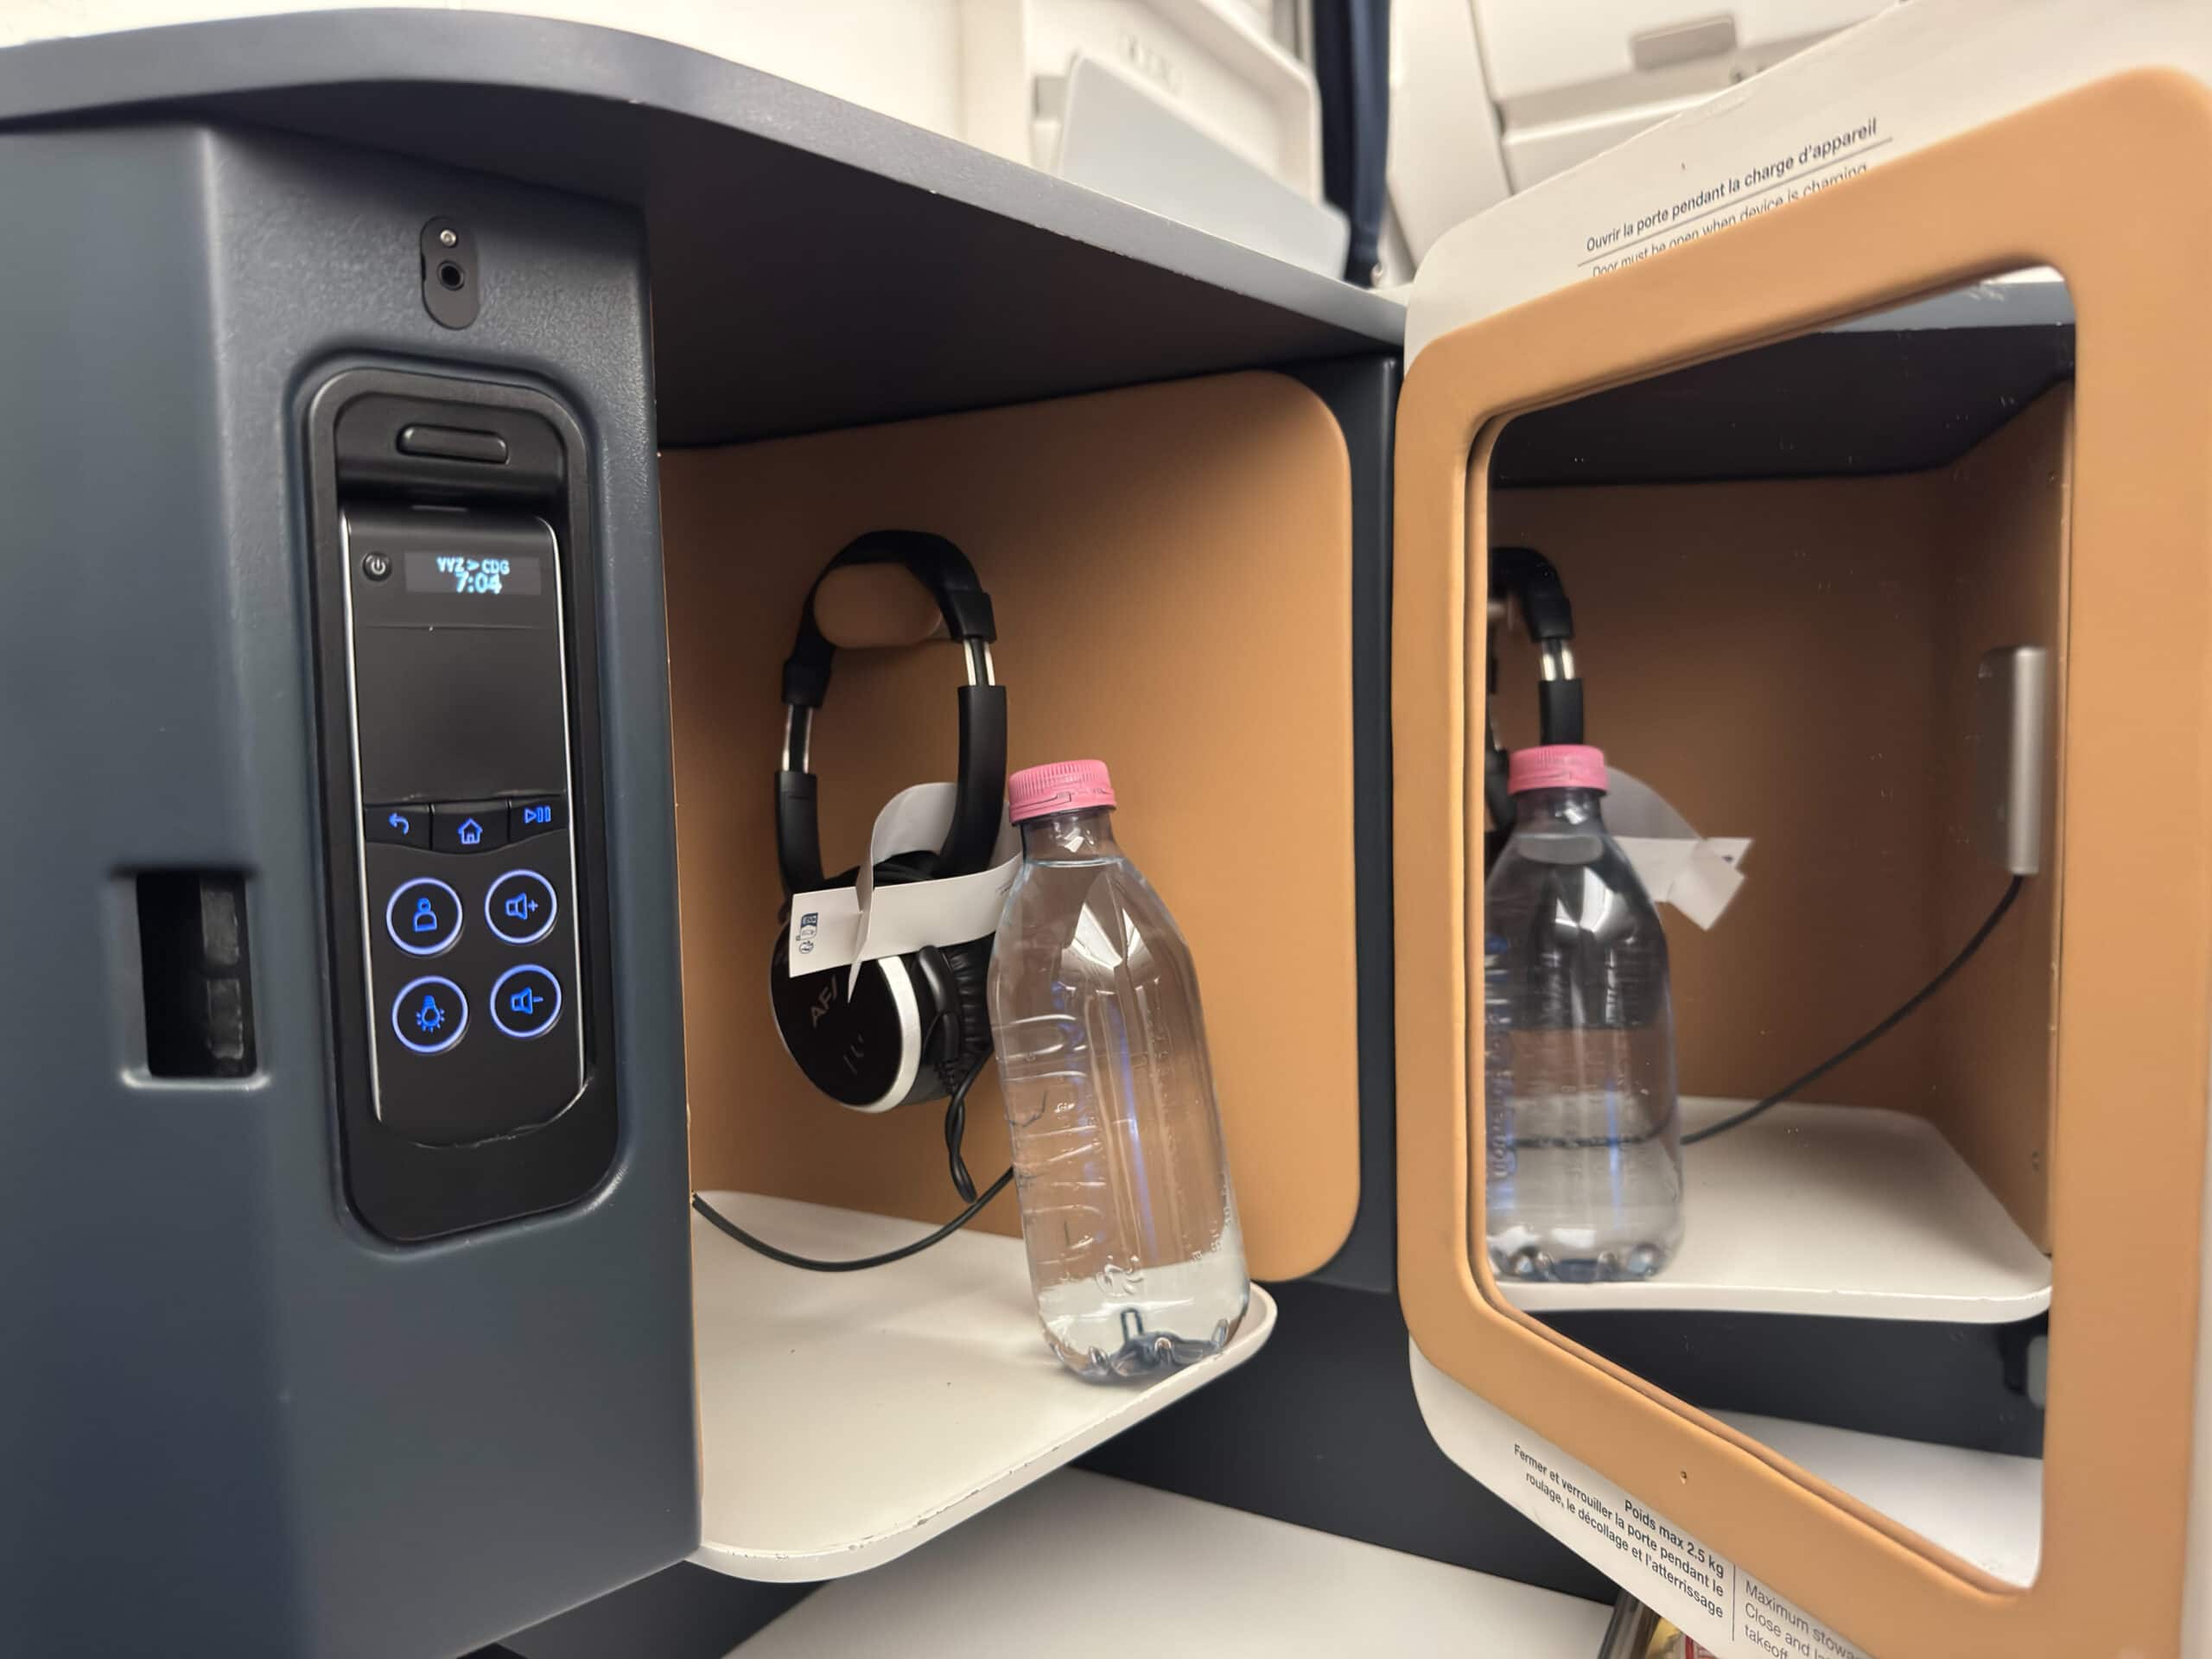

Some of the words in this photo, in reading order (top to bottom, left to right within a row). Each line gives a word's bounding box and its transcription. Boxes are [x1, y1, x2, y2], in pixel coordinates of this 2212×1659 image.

[1586, 228, 1620, 251] Ouvrir
[1624, 222, 1633, 238] la
[1637, 208, 1669, 236] porte
[1672, 181, 1726, 220] pendant
[1728, 178, 1740, 194] la
[1745, 156, 1794, 188] charge
[1798, 118, 1878, 165] d'appareil
[454, 571, 503, 594] 7:04
[481, 558, 511, 575] CDG
[1513, 1443, 1548, 1474] Fermer
[1549, 1468, 1560, 1484] et
[1561, 1477, 1612, 1521] verrouiller
[1615, 1511, 1624, 1529] la
[1627, 1523, 1657, 1552] porte
[1660, 1546, 1709, 1587] pendant
[1712, 1580, 1724, 1598] le
[1525, 1471, 1564, 1508] roulage,
[1567, 1497, 1576, 1514] le
[1578, 1505, 1629, 1552] décollage
[1631, 1547, 1643, 1562] et
[1644, 1554, 1724, 1619] l'atterrissage
[1624, 1499, 1656, 1531] Poids
[1658, 1525, 1685, 1551] max
[1687, 1541, 1706, 1564] 2.5
[1707, 1554, 1725, 1580] kg
[1745, 1580, 1809, 1634] Maximum
[1745, 1601, 1782, 1638] Close
[1784, 1631, 1811, 1657] and
